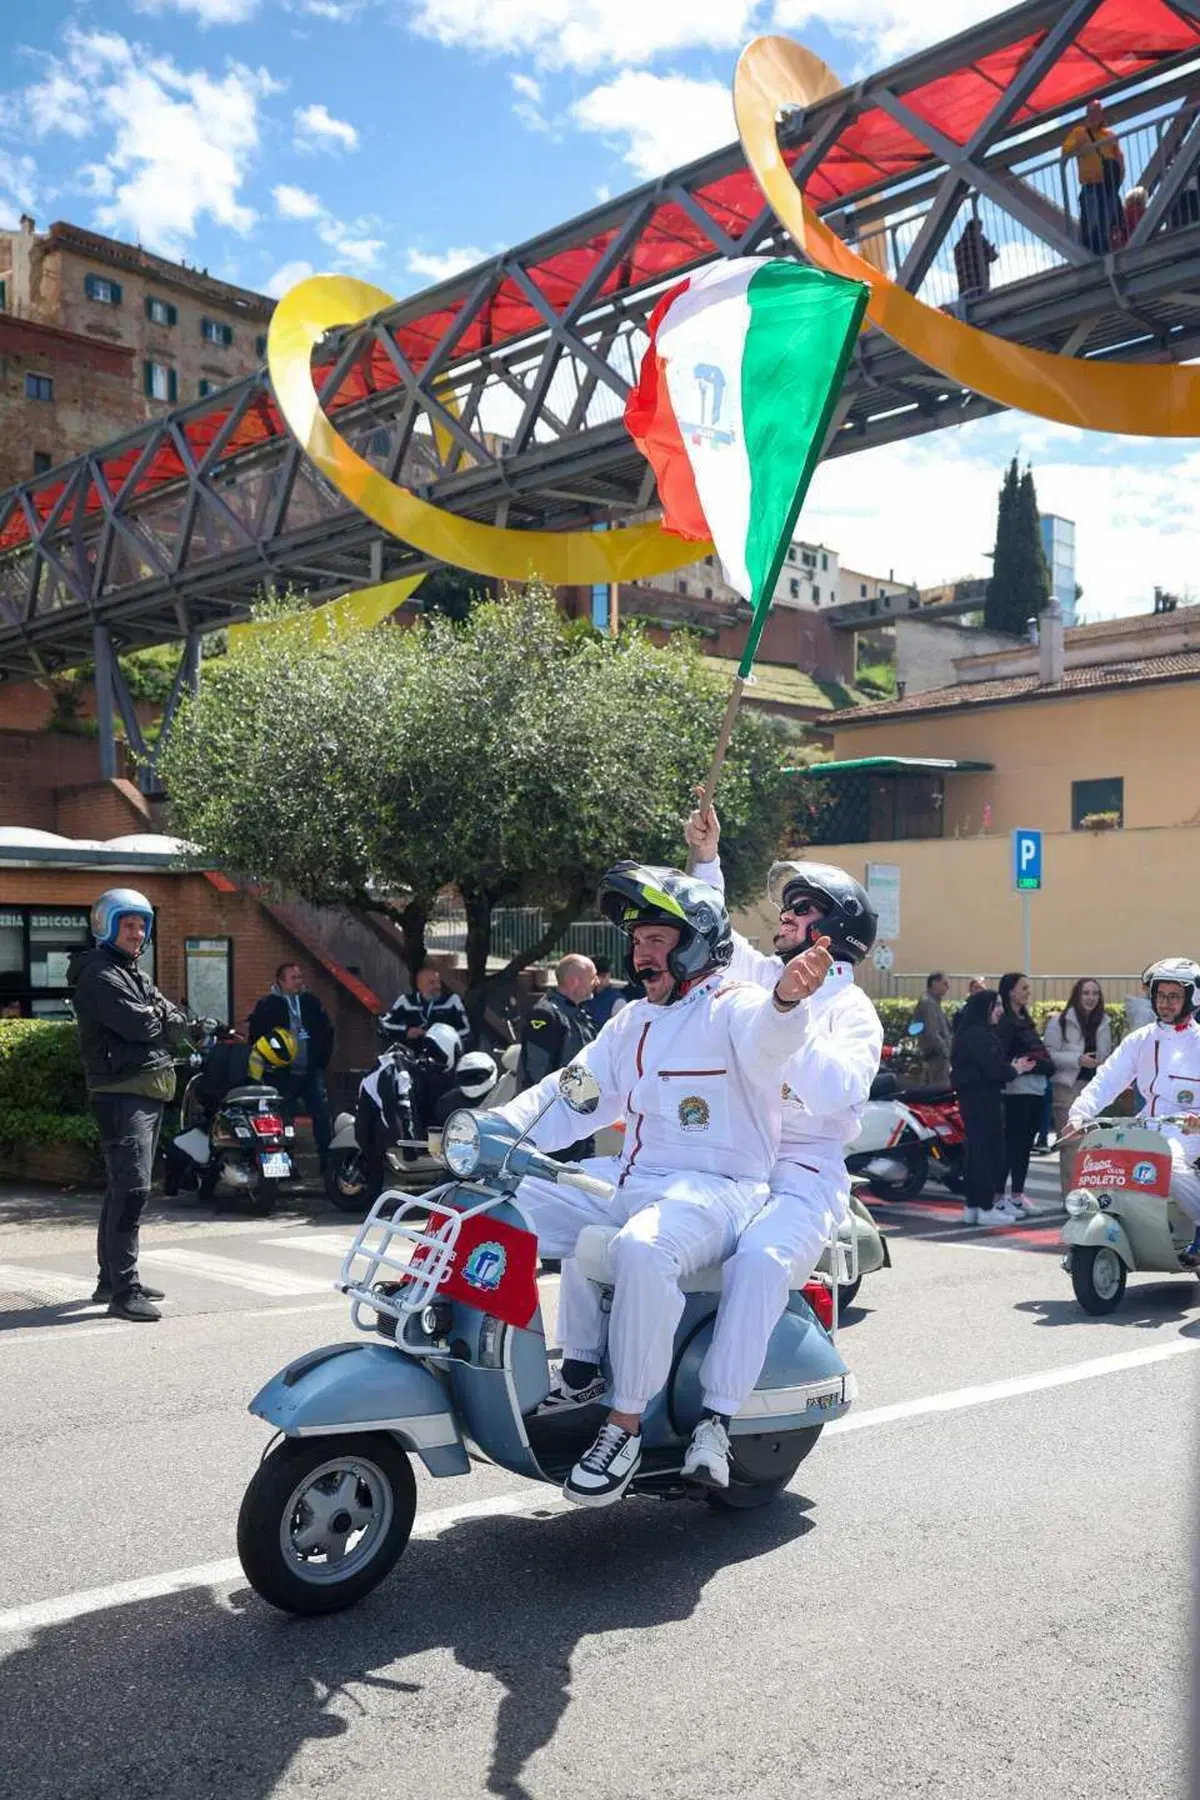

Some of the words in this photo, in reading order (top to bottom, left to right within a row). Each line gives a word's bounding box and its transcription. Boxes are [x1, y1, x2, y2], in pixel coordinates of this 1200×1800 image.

[1021, 839, 1035, 871] P
[31, 915, 88, 928] EDICOLA
[1079, 1175, 1126, 1186] SPOLETO
